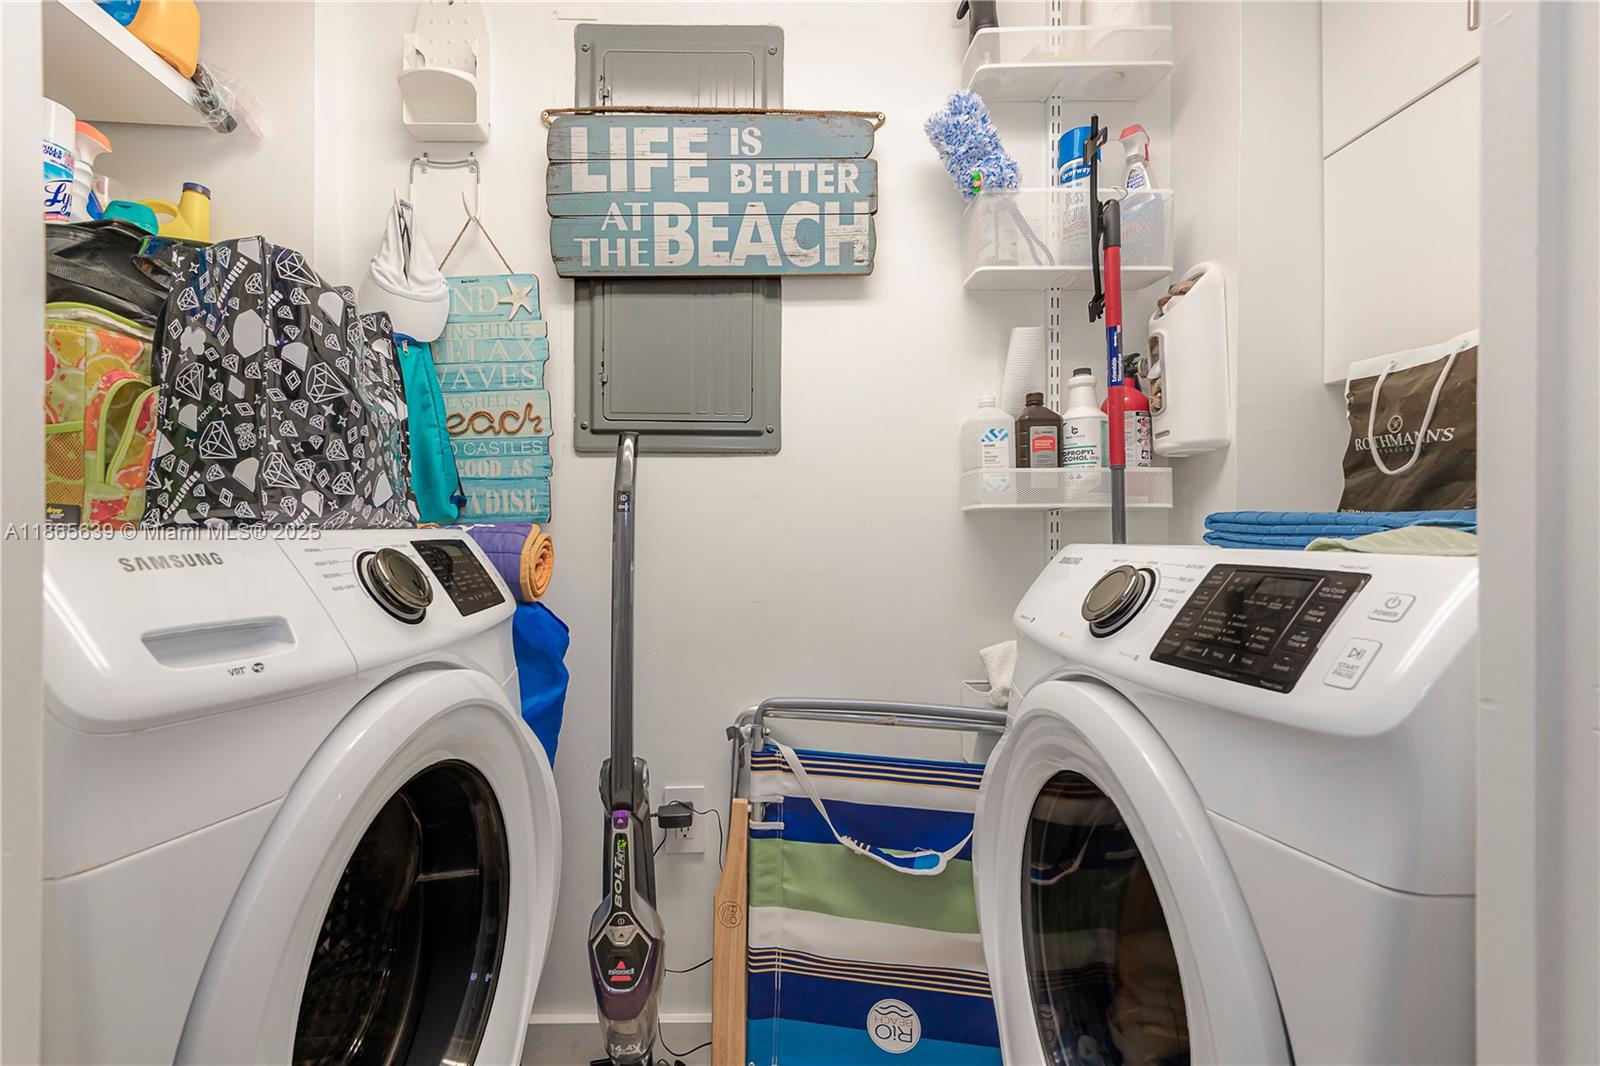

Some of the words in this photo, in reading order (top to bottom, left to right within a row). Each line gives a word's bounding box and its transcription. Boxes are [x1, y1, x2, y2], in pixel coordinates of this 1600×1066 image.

[570, 126, 709, 193] LIFE
[730, 126, 762, 155] IS
[730, 163, 859, 194] BETTER
[600, 202, 649, 231] AT
[574, 238, 649, 267] THE
[653, 200, 870, 267] BEACH
[449, 286, 499, 313] ND
[442, 322, 532, 339] NSHINE
[436, 338, 536, 361] ELAX
[446, 394, 520, 409] EASHELLS
[446, 401, 544, 435] each
[463, 439, 543, 455] CASTLES
[511, 458, 533, 476] AS
[471, 488, 540, 514] ADISE
[118, 552, 223, 573] SAMSUNG
